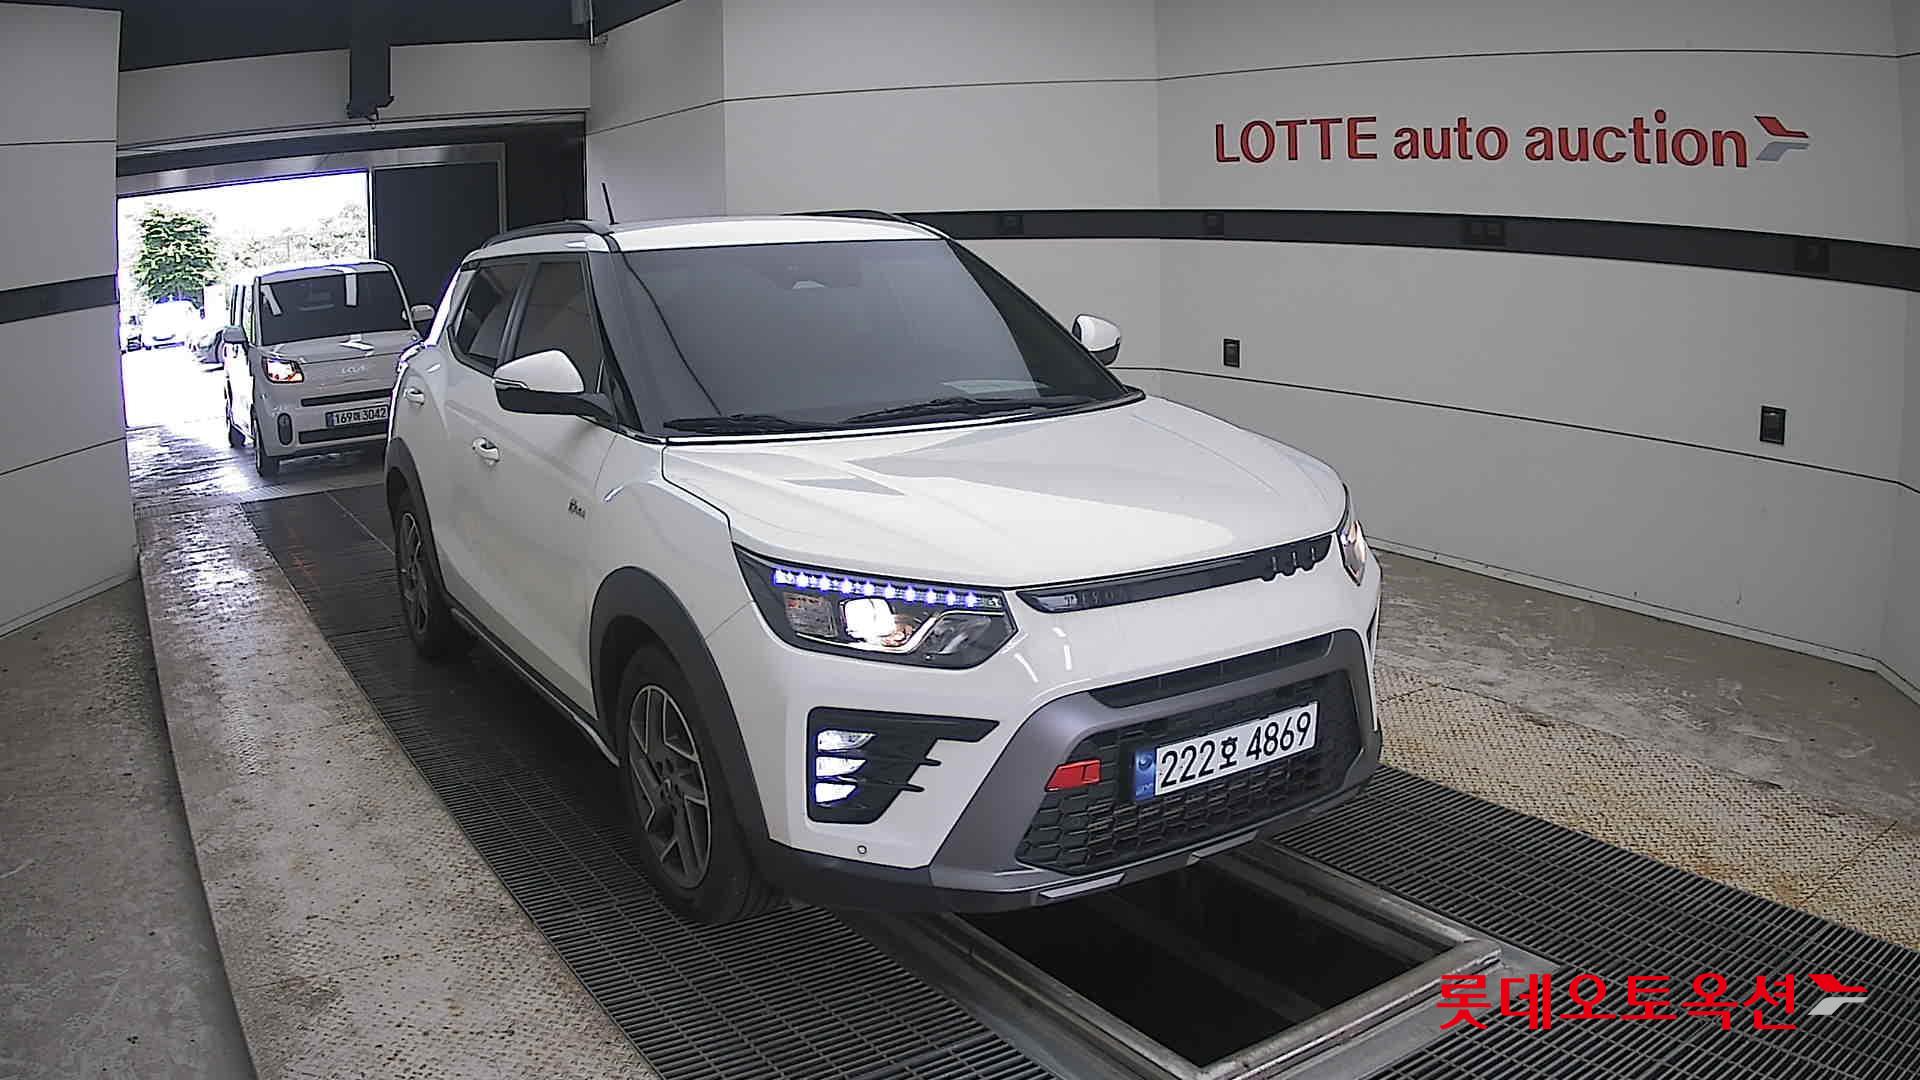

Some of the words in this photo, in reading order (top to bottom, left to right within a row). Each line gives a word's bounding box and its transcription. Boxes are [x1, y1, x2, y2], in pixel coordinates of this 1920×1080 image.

[1215, 115, 1377, 163] LOTTE
[1393, 116, 1509, 161] auto
[1524, 108, 1748, 168] auction
[362, 407, 386, 420] 3042
[1160, 735, 1238, 788] 222호
[1246, 711, 1311, 761] 4869
